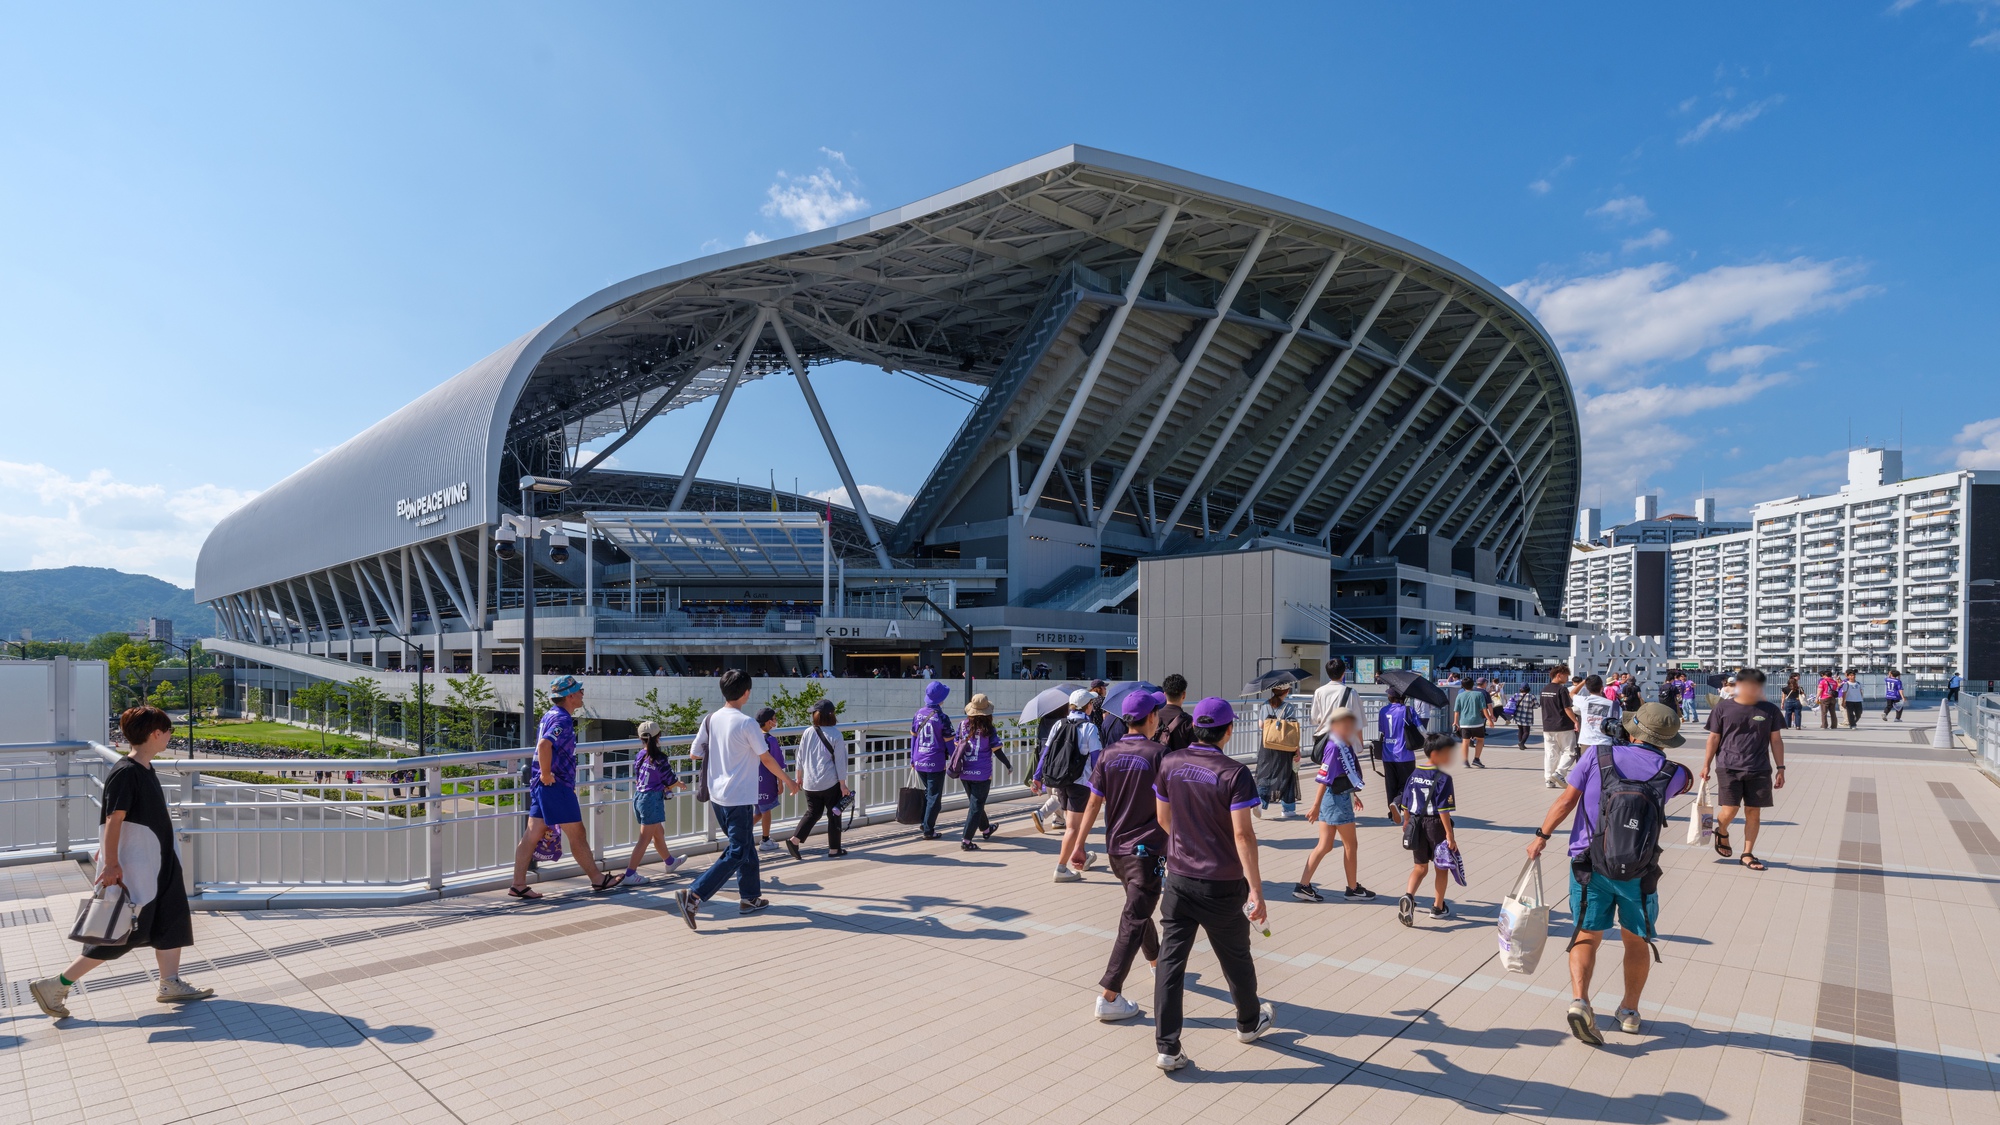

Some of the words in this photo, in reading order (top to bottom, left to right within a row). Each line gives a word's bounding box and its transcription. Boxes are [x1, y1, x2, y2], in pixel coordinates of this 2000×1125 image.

[417, 490, 443, 517] PEACE
[442, 482, 468, 507] WING
[839, 627, 848, 637] D
[852, 627, 860, 637] H
[885, 620, 901, 638] A
[1036, 633, 1045, 642] F1
[1047, 633, 1056, 643] F2
[1058, 634, 1067, 643] B1
[1068, 634, 1078, 644] B2
[1572, 634, 1667, 658] EDION
[1572, 657, 1668, 682] PEACE
